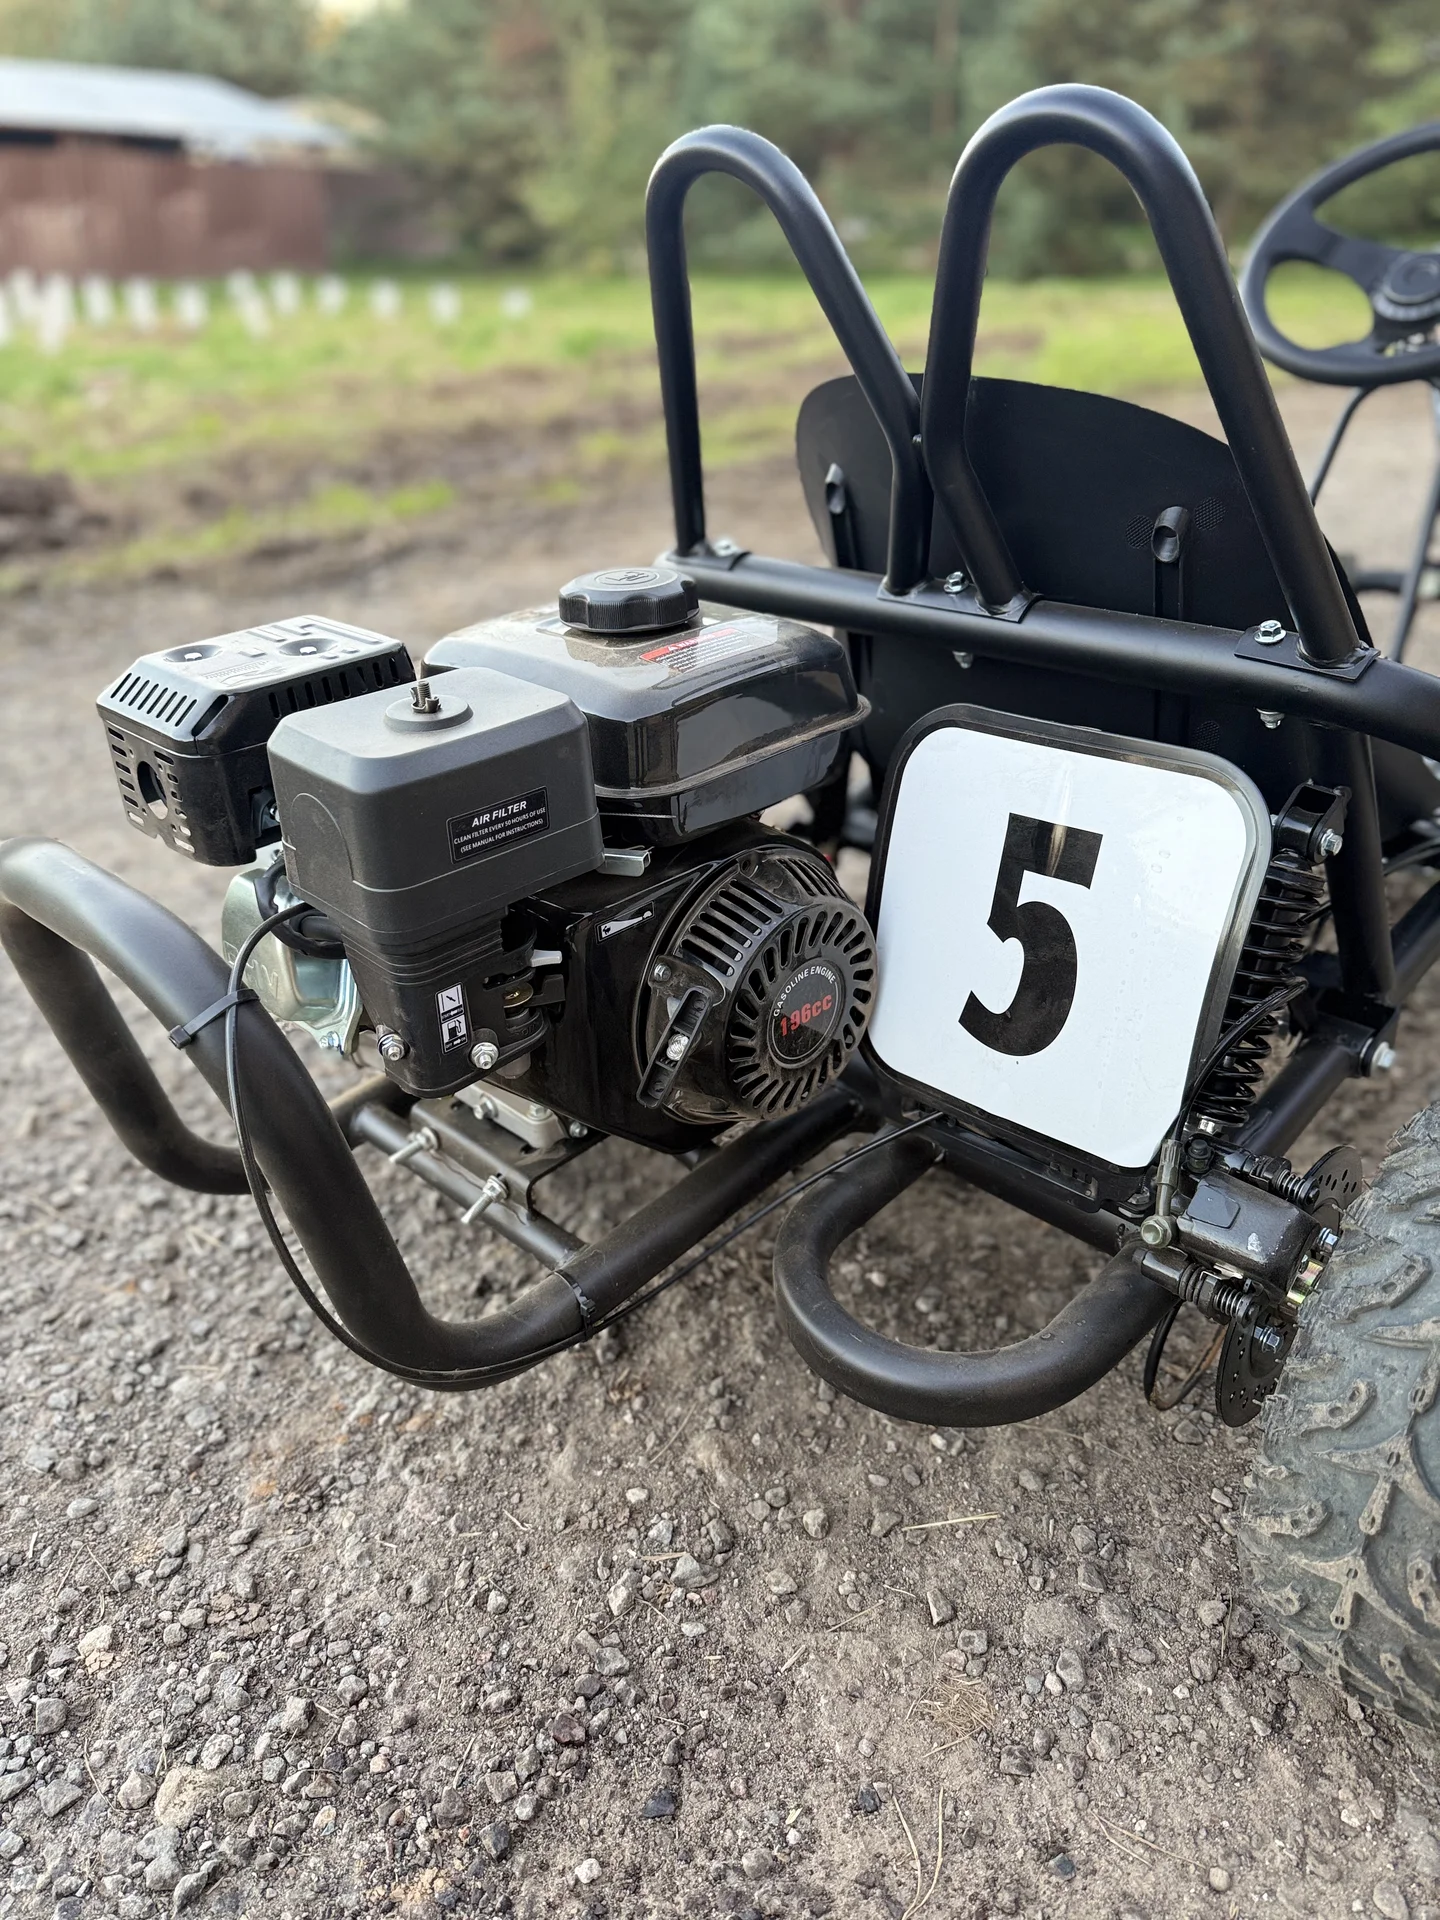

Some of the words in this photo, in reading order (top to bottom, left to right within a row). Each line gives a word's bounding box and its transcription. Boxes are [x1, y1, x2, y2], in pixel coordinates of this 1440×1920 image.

[453, 833, 472, 845] CLEAN
[471, 828, 489, 838] FILTER
[489, 822, 505, 833] EVERY
[504, 819, 512, 827] 50
[511, 813, 529, 824] HOURS
[536, 806, 546, 816] USE
[471, 813, 490, 828] AIR
[492, 801, 527, 820] FILTER
[460, 844, 472, 853] (SEE
[472, 836, 495, 848] MANUAL
[495, 831, 505, 840] FOR
[506, 818, 544, 836] INSTRUCTIONS)
[958, 812, 1104, 1057] 5
[773, 968, 809, 1017] GASOLINE
[810, 965, 836, 984] ENGINE
[780, 994, 832, 1037] 196cc
